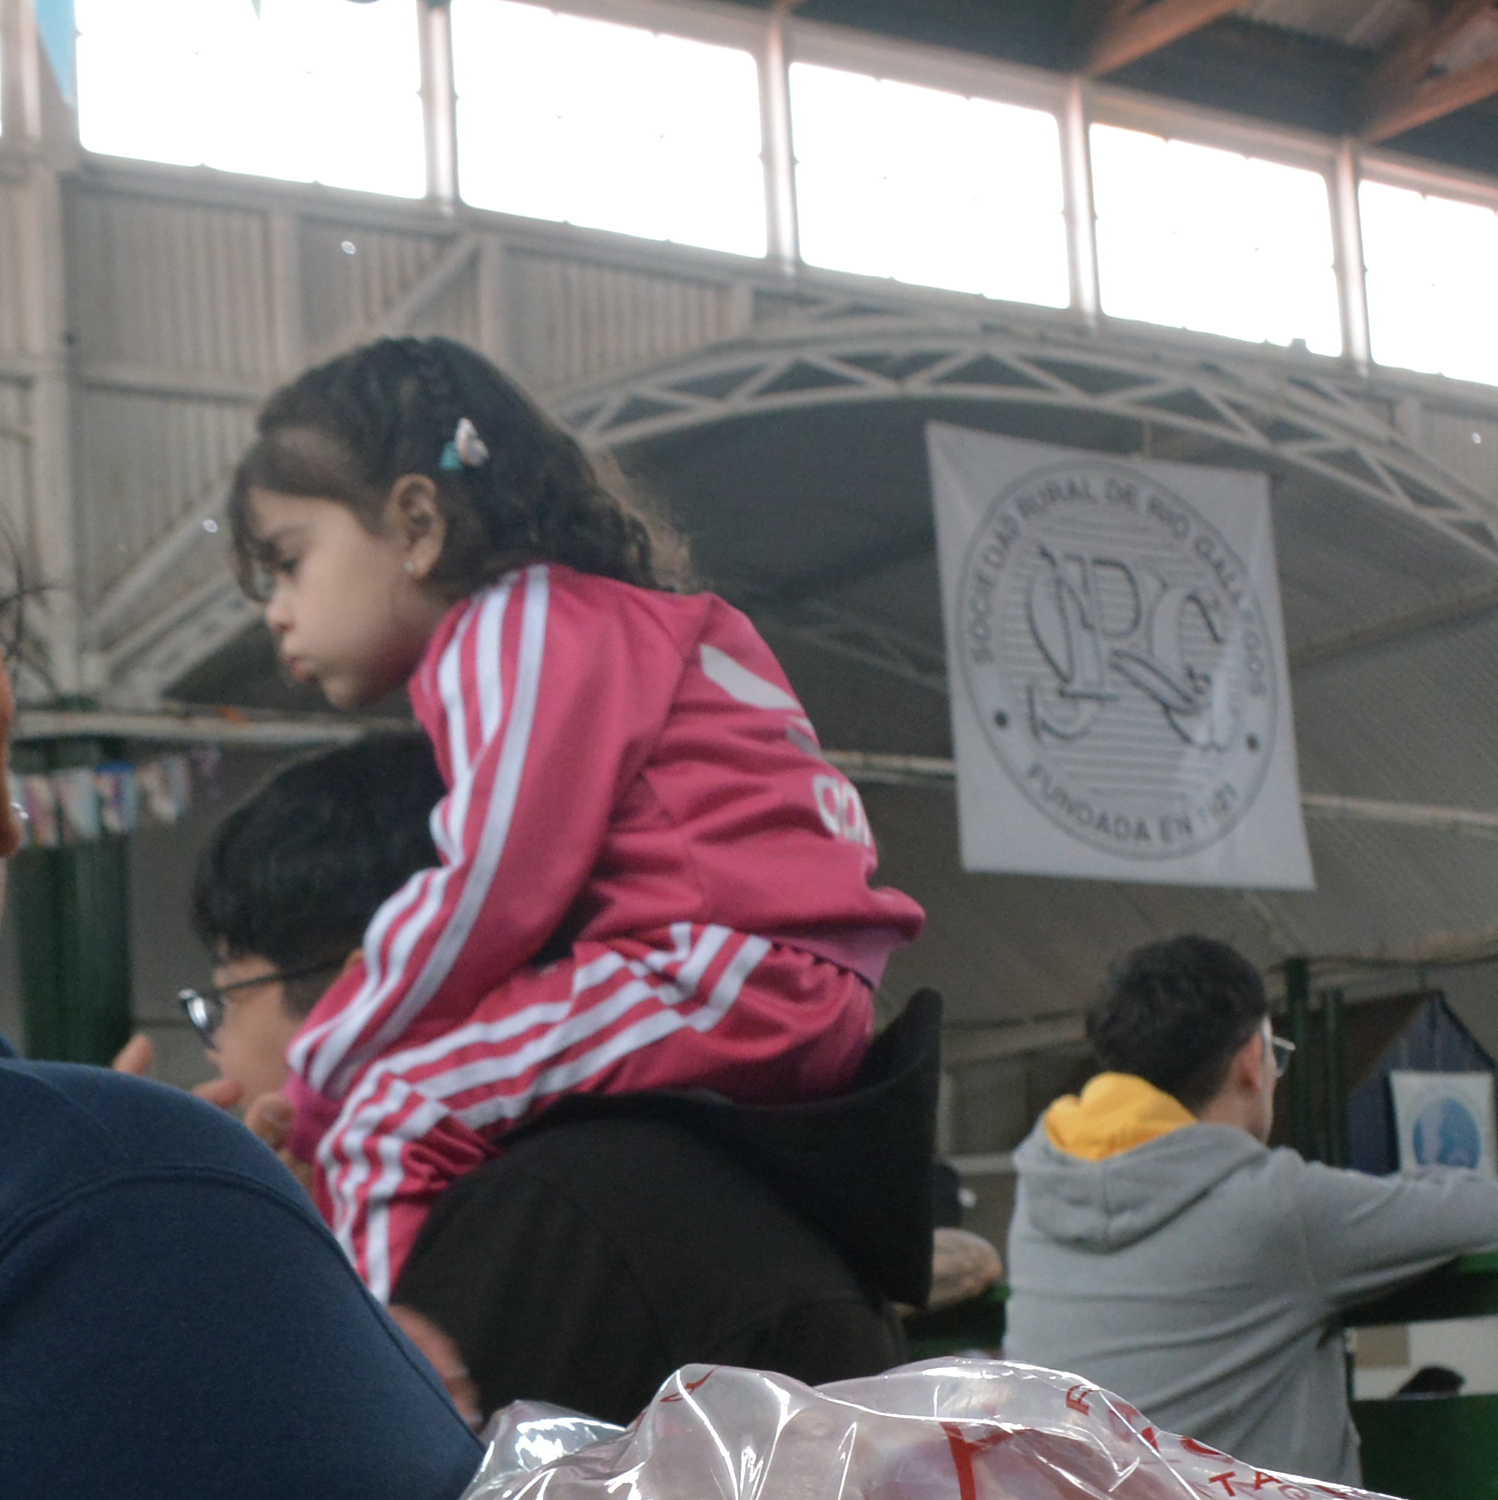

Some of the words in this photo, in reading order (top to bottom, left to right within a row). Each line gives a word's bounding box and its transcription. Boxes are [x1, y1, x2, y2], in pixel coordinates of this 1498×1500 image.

[968, 512, 1021, 665] SOCIEDAD
[1017, 478, 1096, 520] RURAL
[1106, 477, 1141, 511] DE
[1028, 763, 1151, 843] FUNDADA
[1159, 813, 1194, 844] EN
